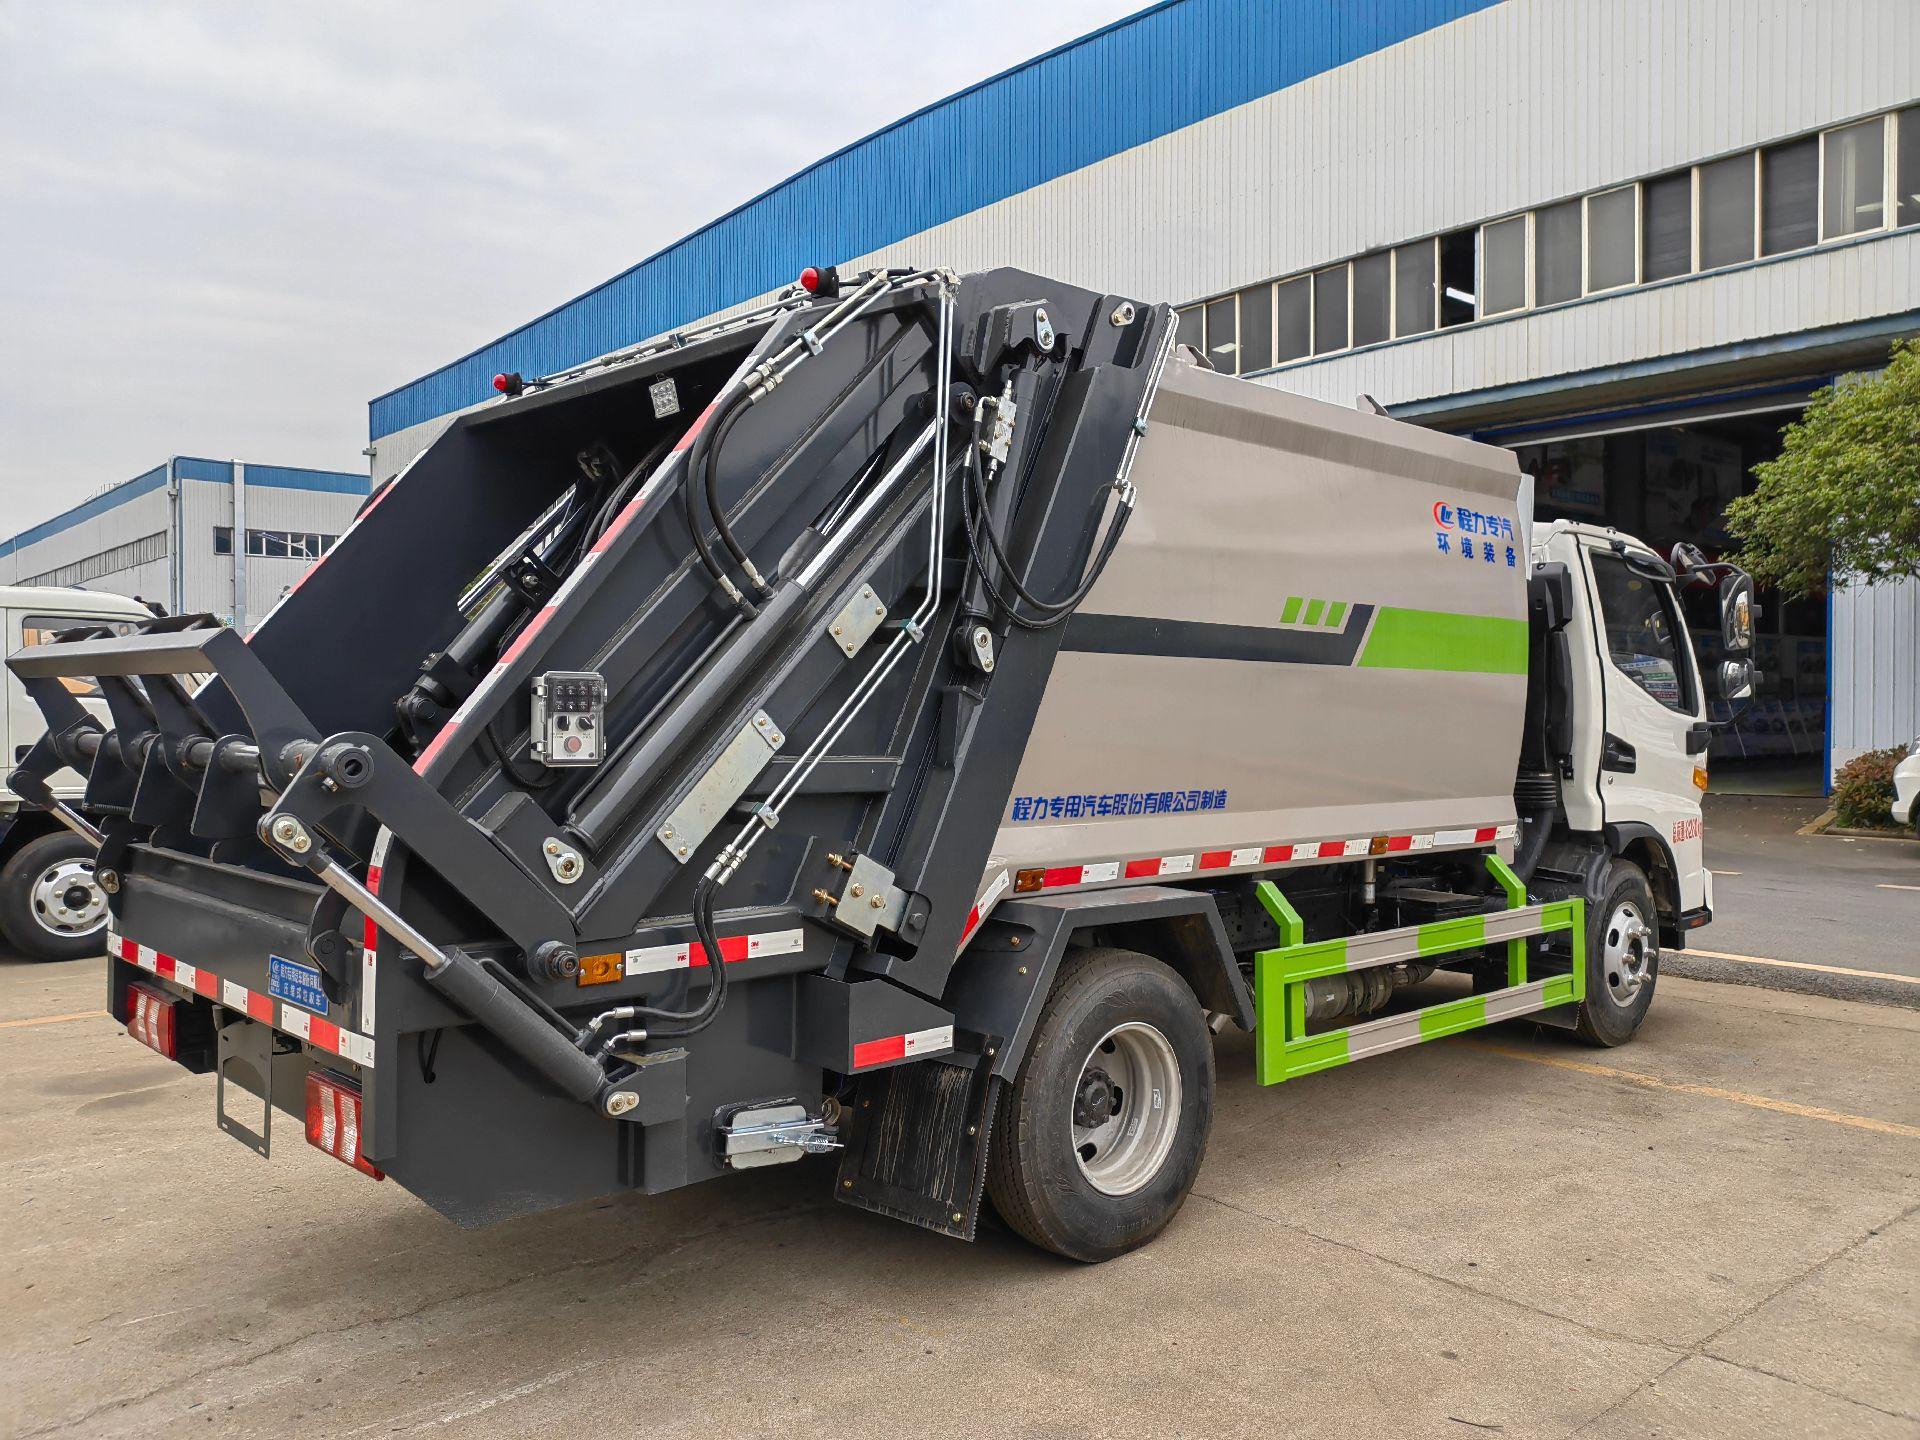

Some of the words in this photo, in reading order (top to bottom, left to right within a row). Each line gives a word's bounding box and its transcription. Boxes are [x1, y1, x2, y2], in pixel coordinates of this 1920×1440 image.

[1456, 507, 1514, 541] 程力专汽
[1436, 532, 1516, 568] 环境装备
[1011, 789, 1228, 822] 程力专用汽车股份有限公司制造
